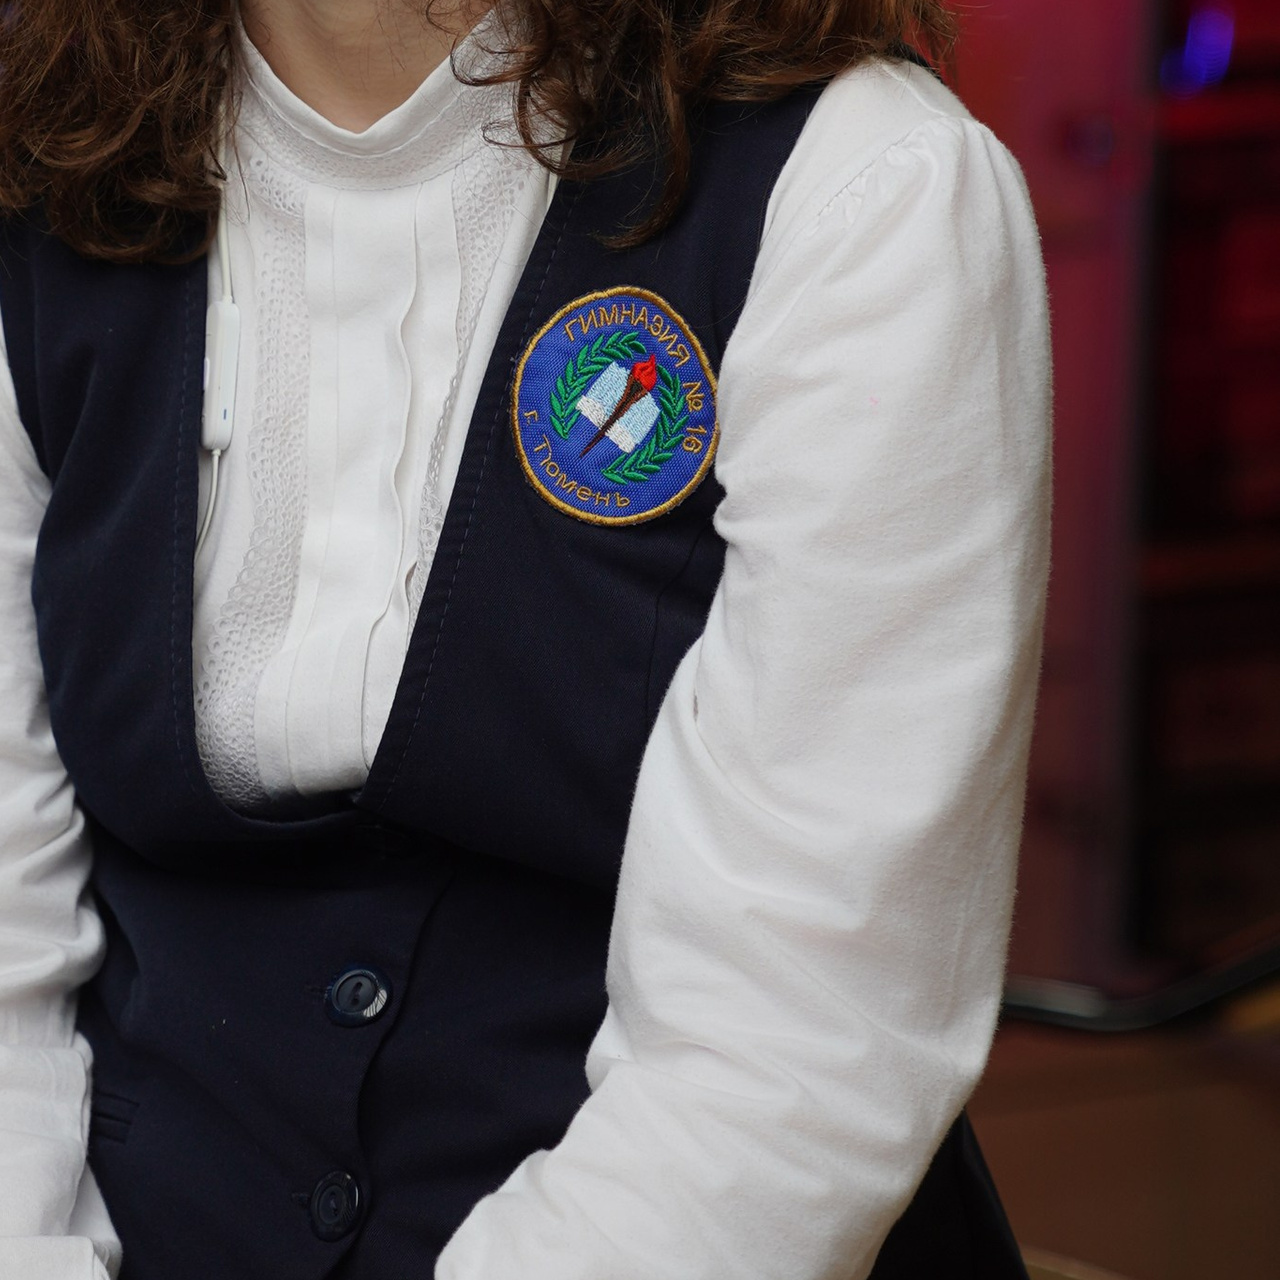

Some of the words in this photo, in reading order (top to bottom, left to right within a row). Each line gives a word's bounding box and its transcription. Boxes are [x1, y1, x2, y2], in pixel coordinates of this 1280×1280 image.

[563, 303, 690, 367] ГИМНАЗИЯ
[683, 381, 704, 413] №
[682, 424, 708, 455] 16
[533, 434, 631, 508] Тюмень
